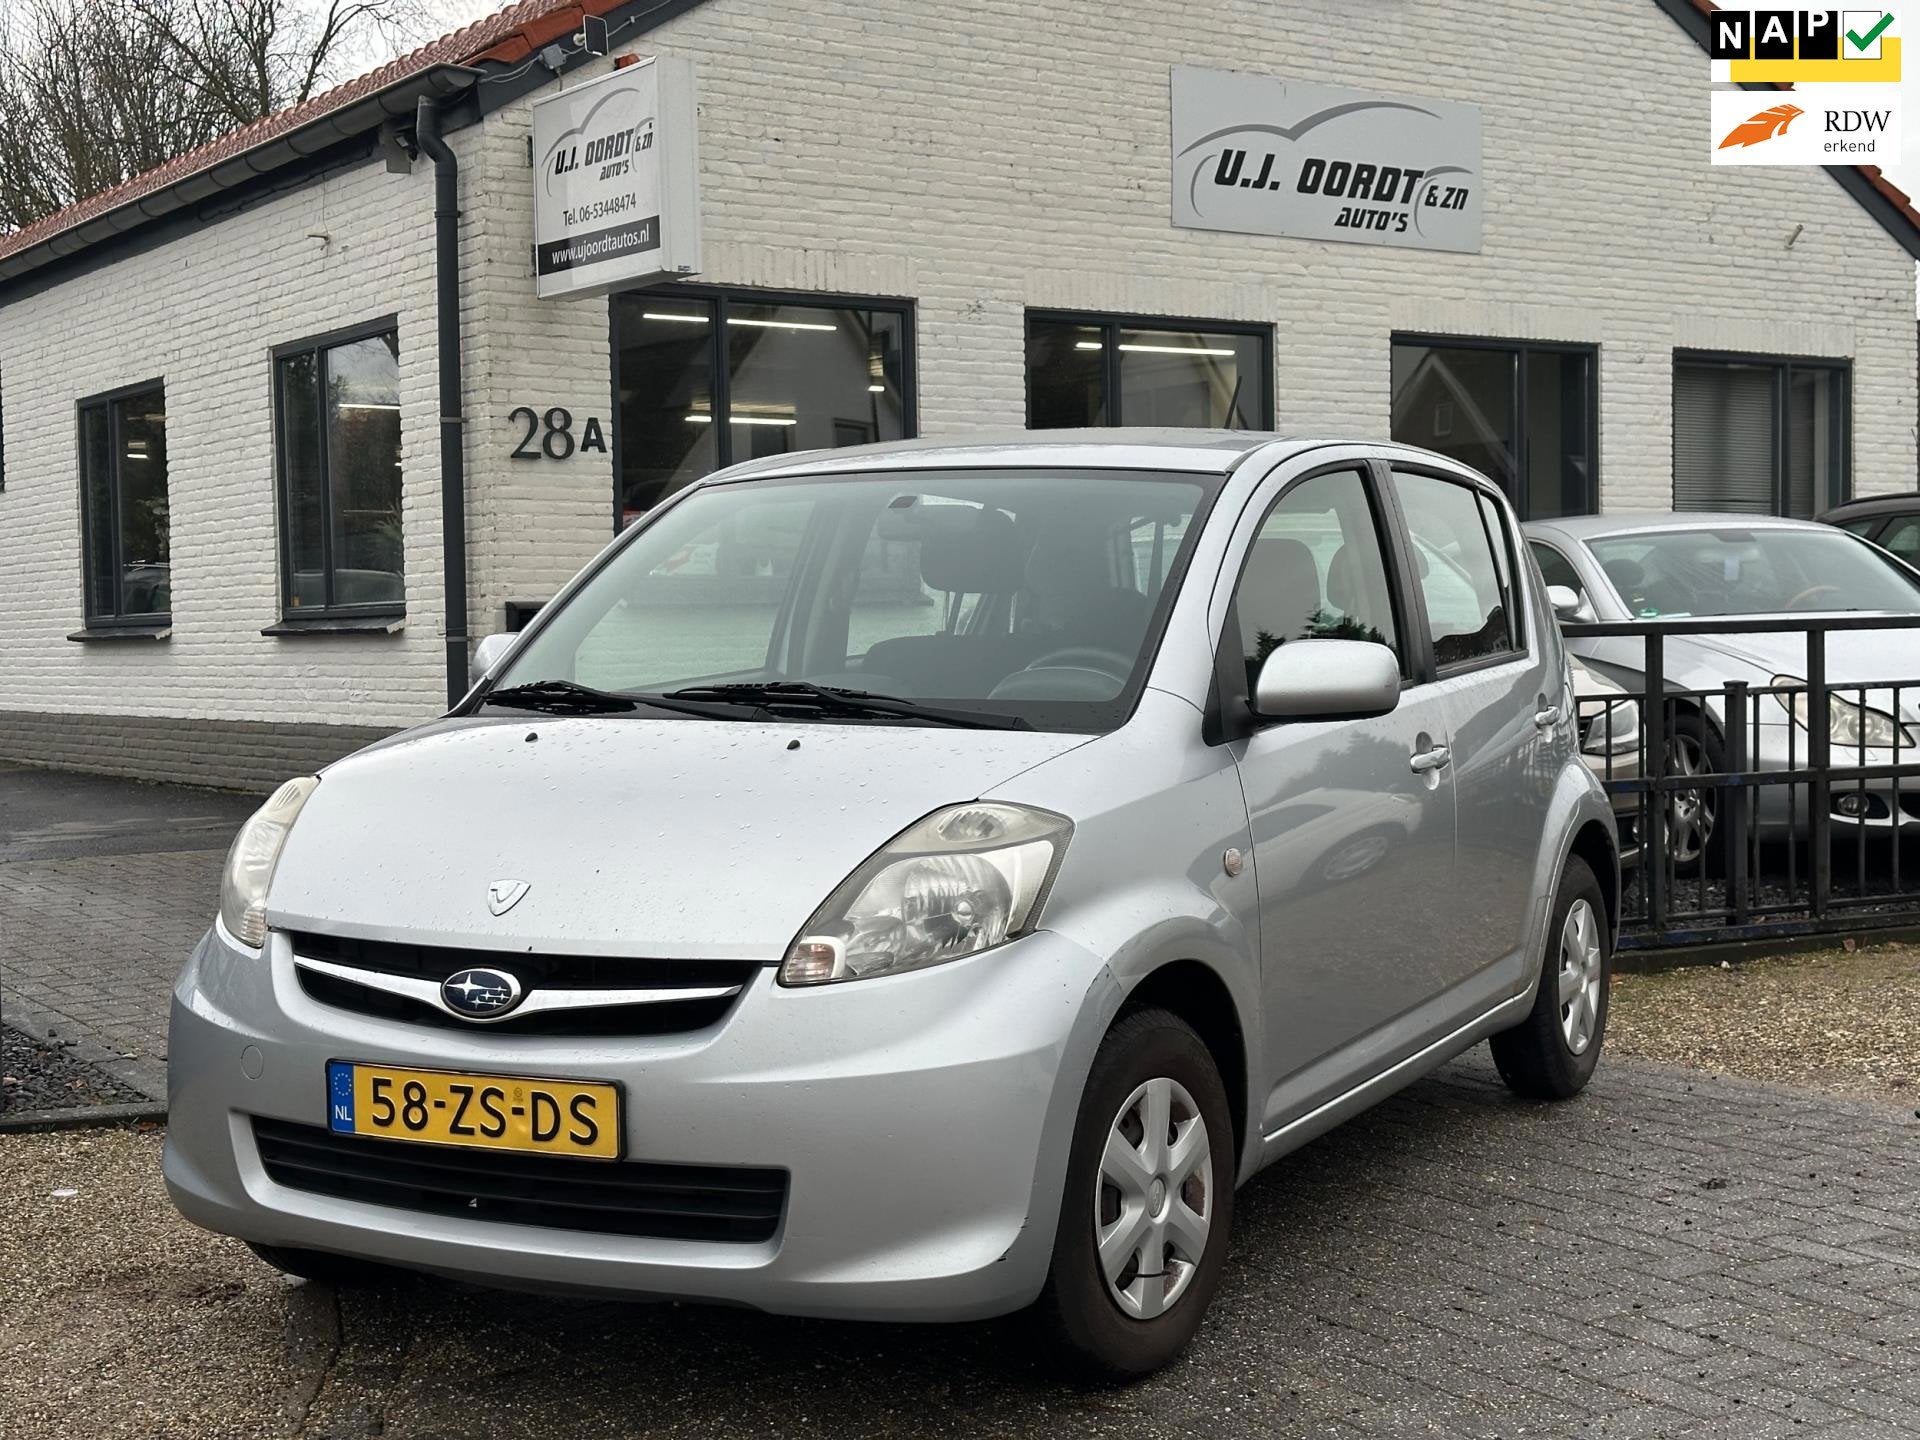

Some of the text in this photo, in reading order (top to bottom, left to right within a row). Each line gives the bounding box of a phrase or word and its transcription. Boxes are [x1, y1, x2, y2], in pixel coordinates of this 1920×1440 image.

[554, 146, 579, 175] U.J.
[584, 128, 634, 166] OORDT
[1214, 149, 1280, 191] U.J.
[1296, 158, 1425, 204] OORDT
[563, 192, 637, 227] Tel. 06-53448474
[551, 224, 650, 264] www.ujoordtautos.nl
[335, 1076, 599, 1146] NL 58-ZS-DS
